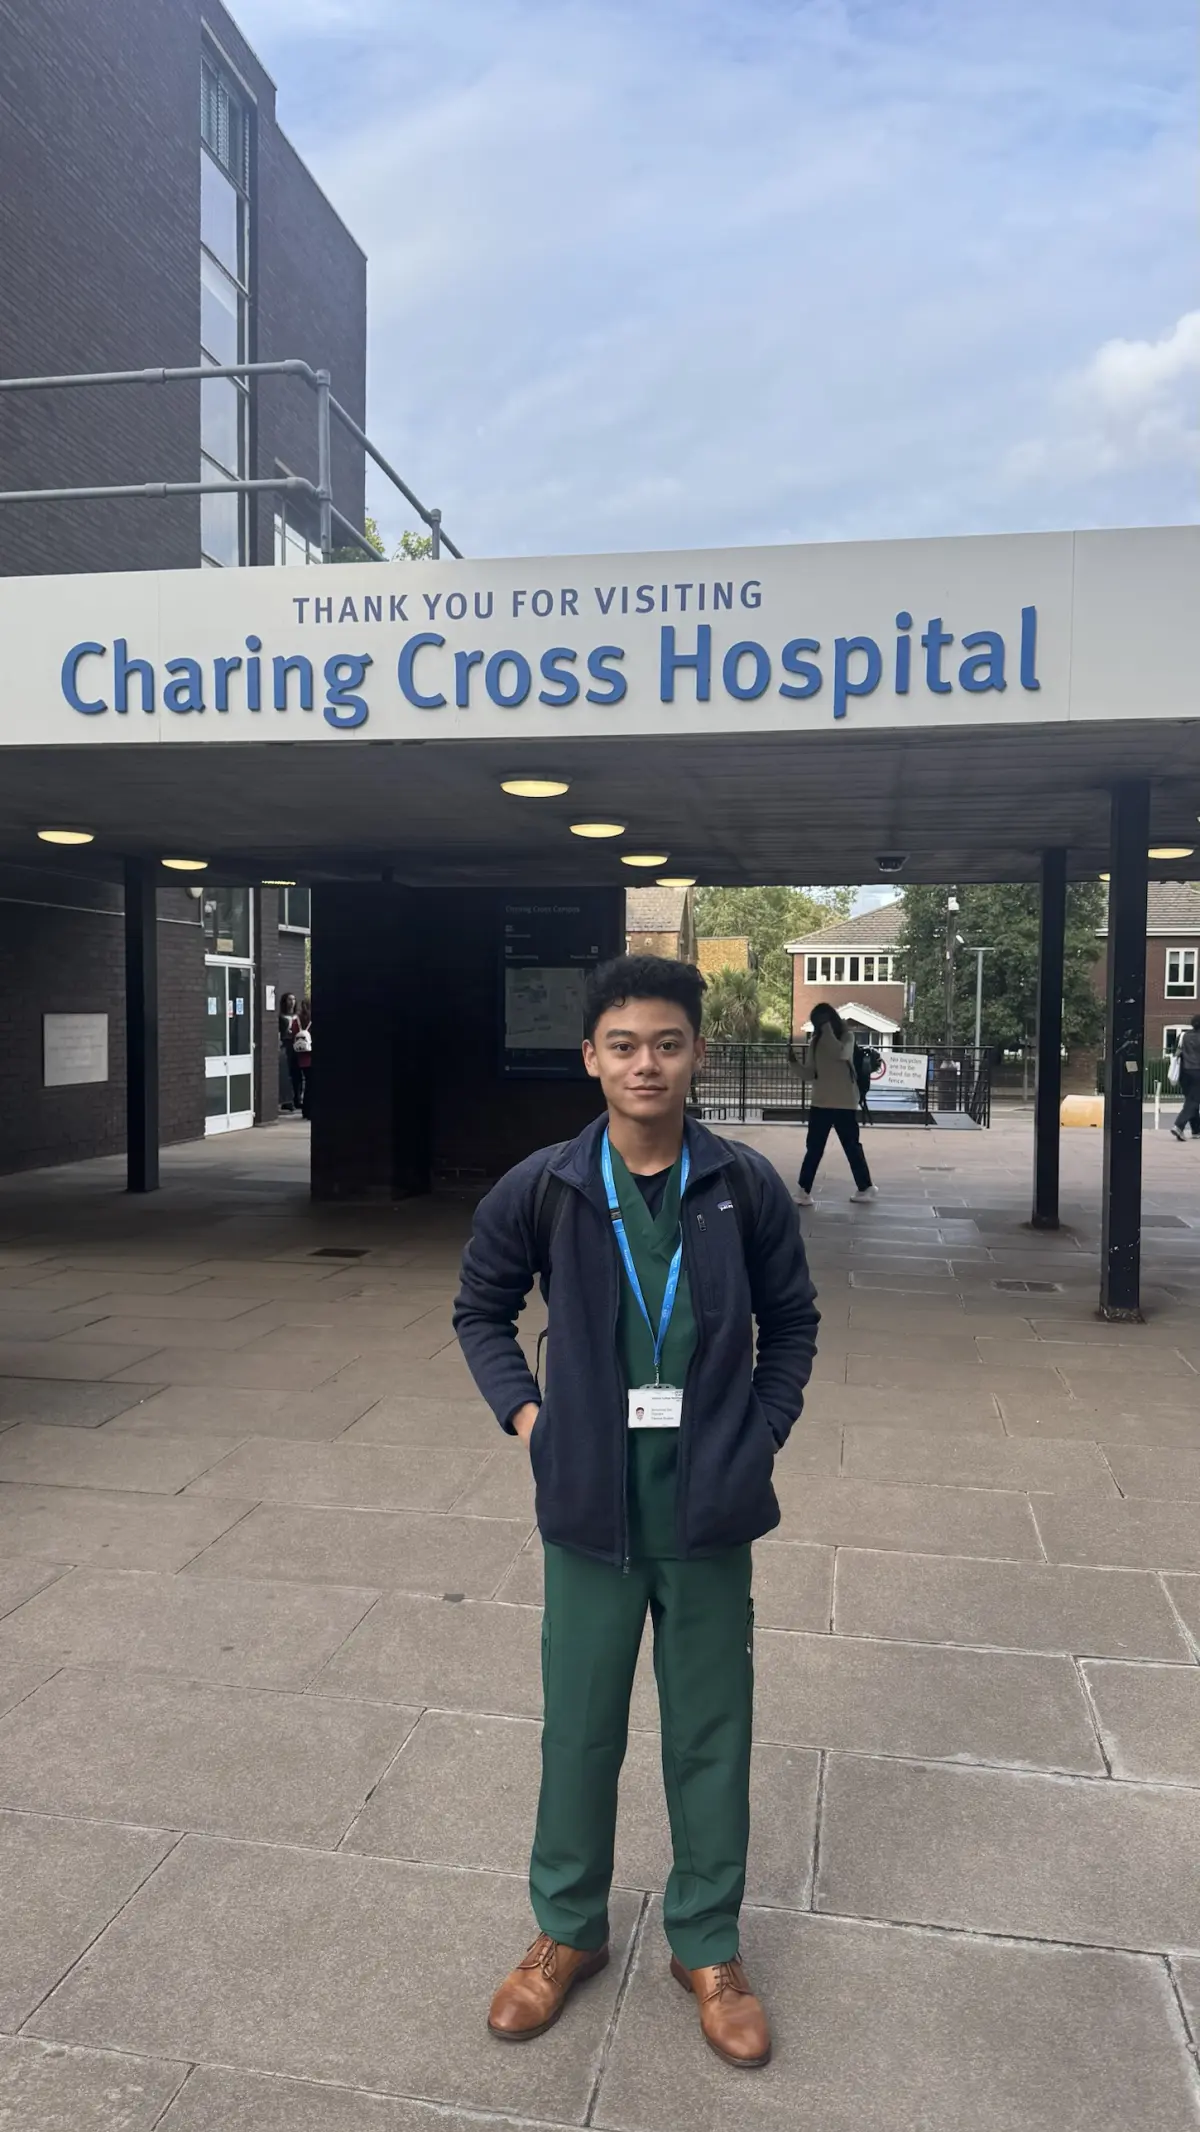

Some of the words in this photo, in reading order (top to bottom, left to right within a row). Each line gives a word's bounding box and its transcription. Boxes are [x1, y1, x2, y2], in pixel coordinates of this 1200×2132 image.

[292, 594, 409, 624] THANK
[422, 590, 495, 621] YOU
[512, 588, 580, 618] FOR
[594, 579, 763, 616] VISITING
[61, 634, 373, 728] Charing
[397, 632, 627, 708] Cross
[659, 605, 1041, 719] Hospital
